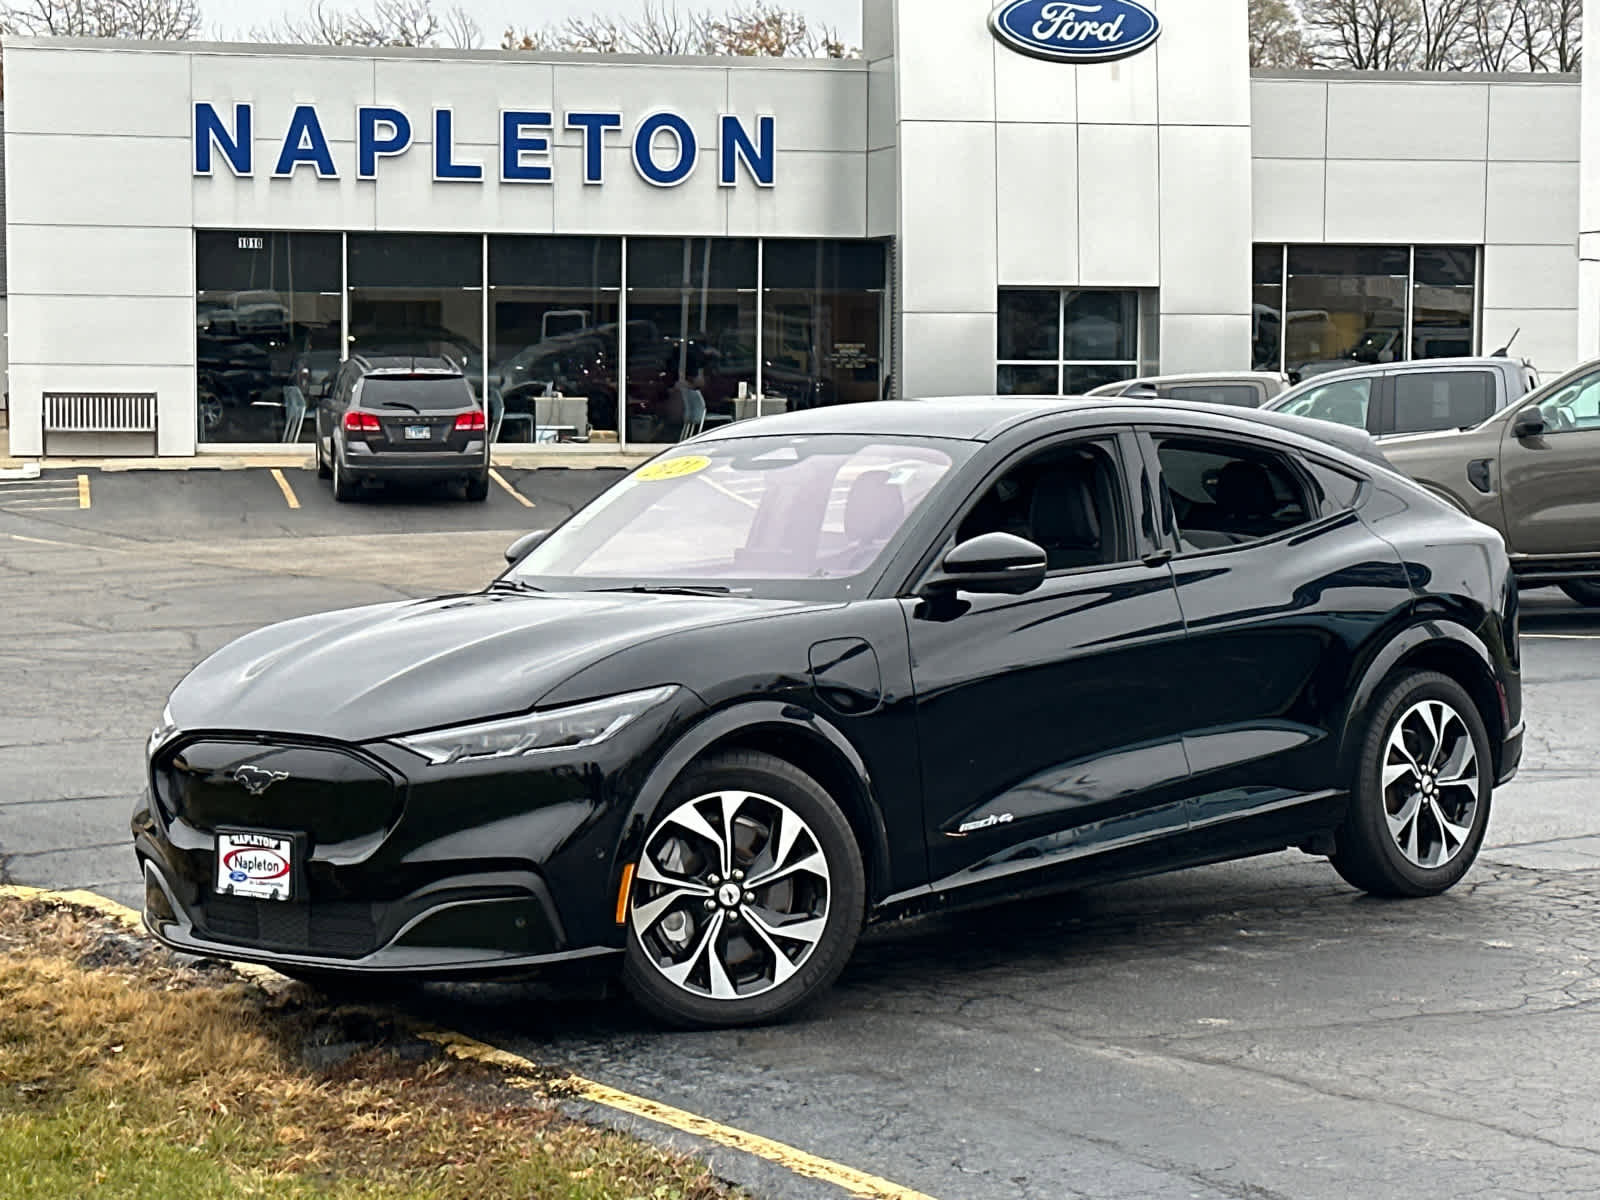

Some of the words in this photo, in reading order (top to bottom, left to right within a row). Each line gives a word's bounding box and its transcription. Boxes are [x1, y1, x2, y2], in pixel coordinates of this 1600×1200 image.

[1032, 2, 1126, 42] Ford
[192, 101, 775, 188] NAPLETON
[238, 237, 263, 249] 1010
[234, 853, 279, 873] Napleton
